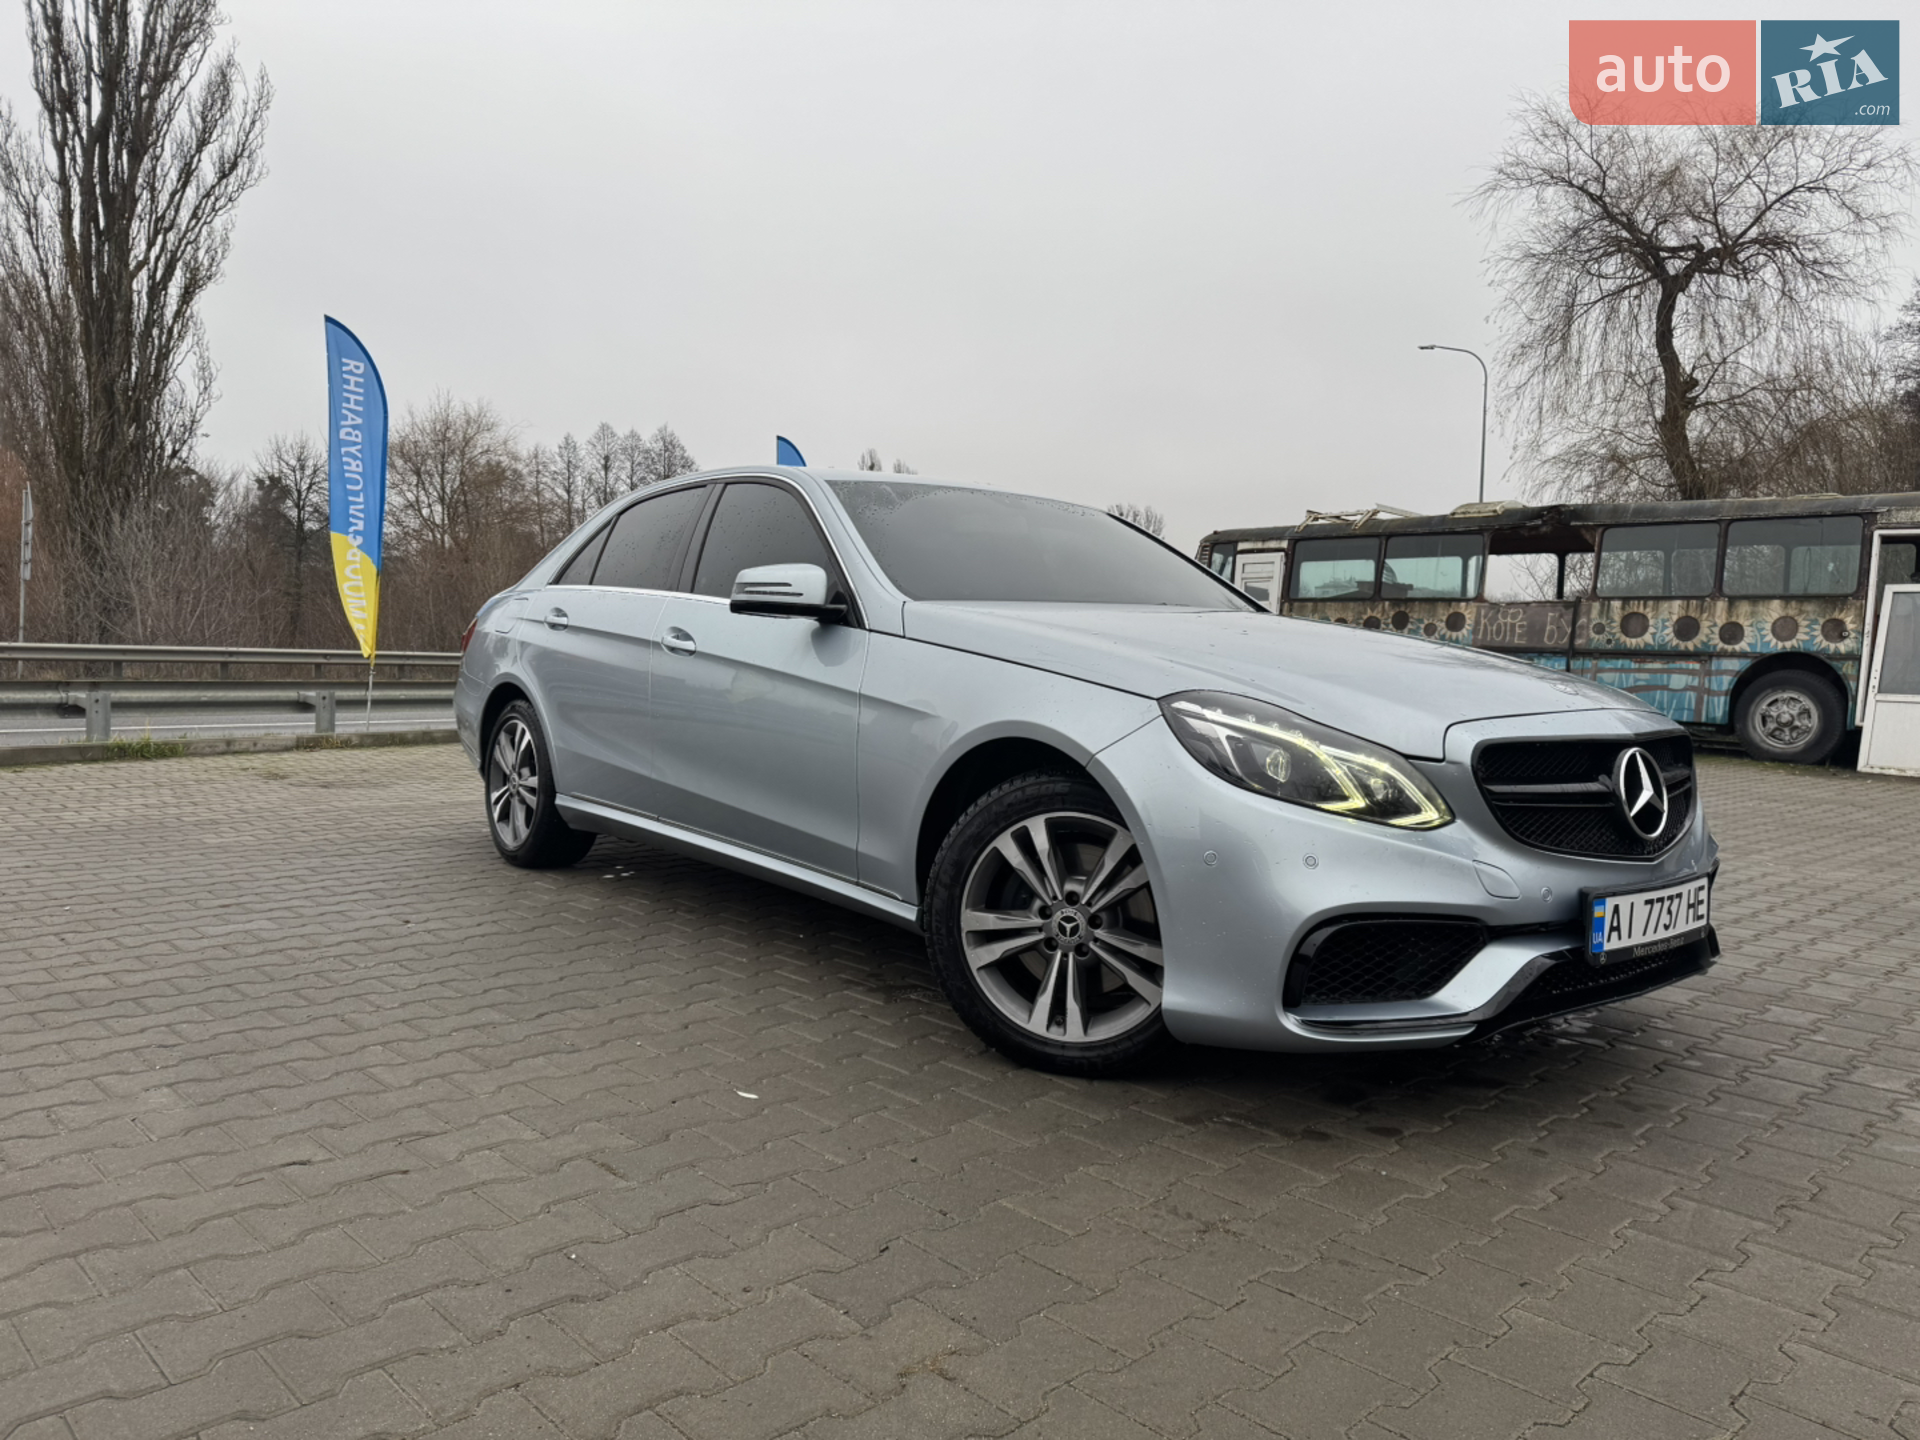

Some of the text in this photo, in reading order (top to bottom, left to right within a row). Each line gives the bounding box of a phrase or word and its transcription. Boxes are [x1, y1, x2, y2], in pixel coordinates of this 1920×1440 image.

[1607, 885, 1705, 942] AI 7737 HE
[1593, 932, 1604, 944] UA
[1633, 937, 1684, 957] Mercedes-Benz
